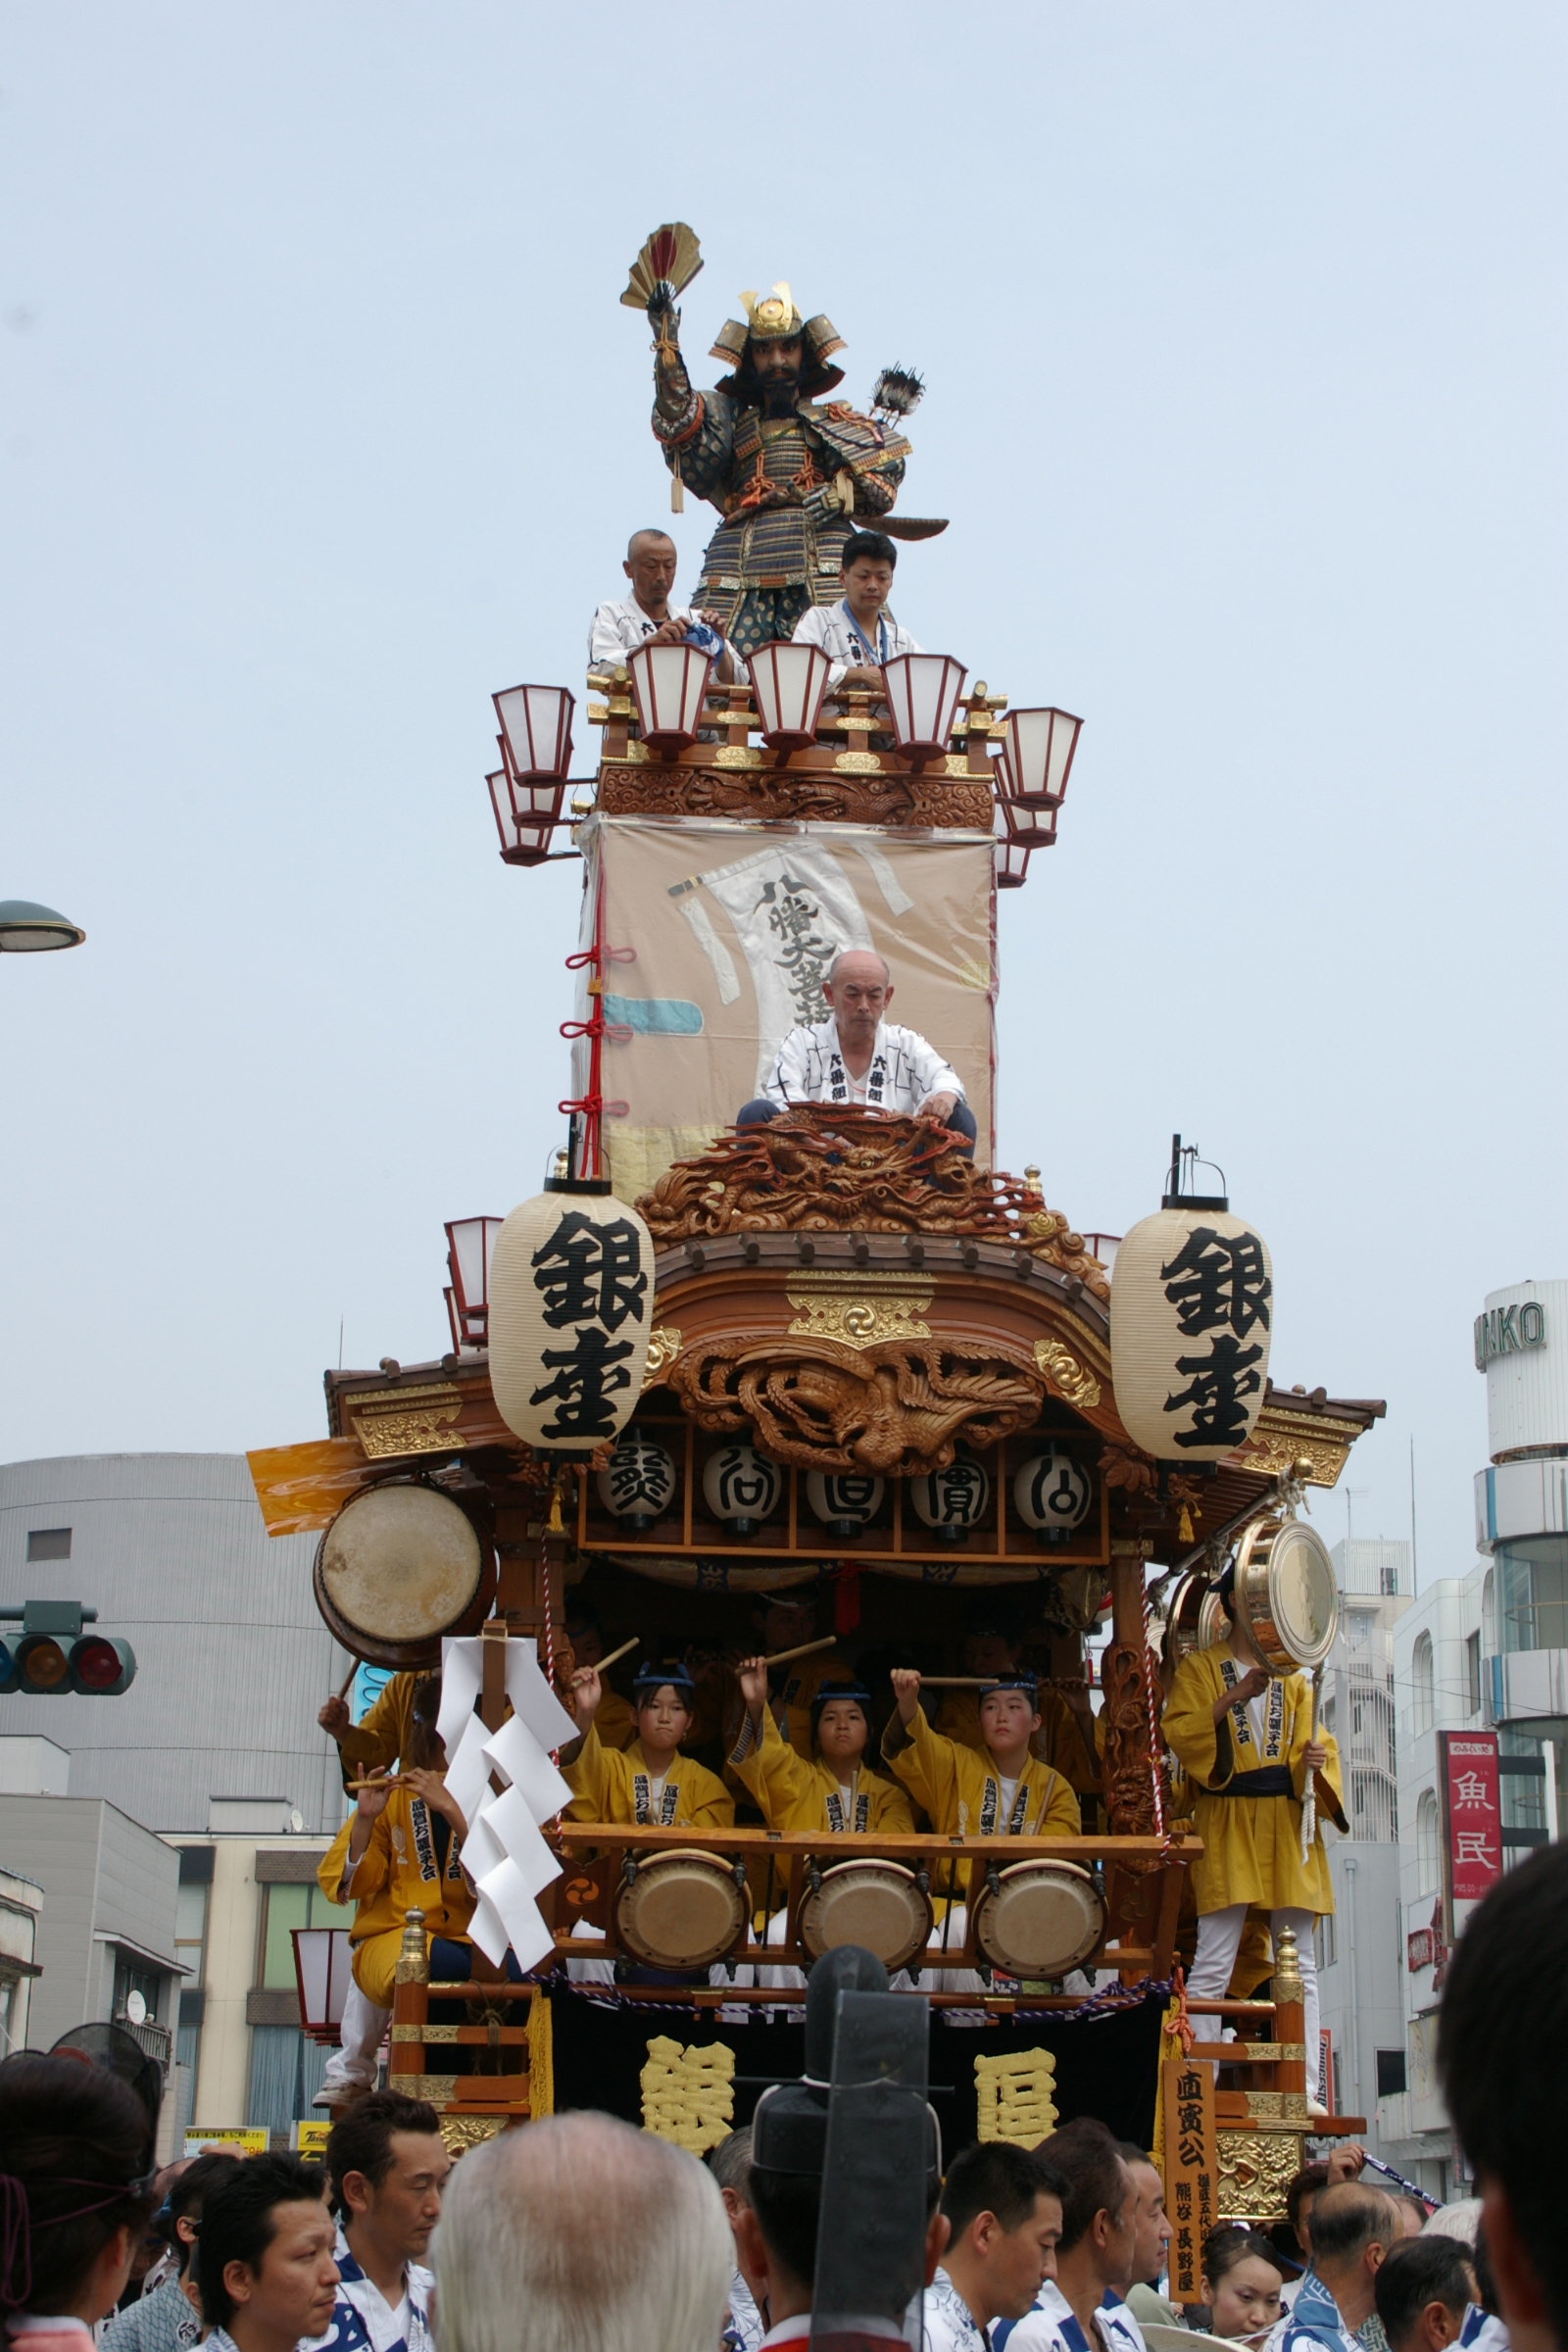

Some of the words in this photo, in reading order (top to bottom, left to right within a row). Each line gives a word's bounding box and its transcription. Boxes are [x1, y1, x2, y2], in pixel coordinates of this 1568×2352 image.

[1452, 1771, 1497, 1869] 魚民
[1175, 2182, 1192, 2222] 熊谷
[1177, 2228, 1195, 2292] 長野屋
